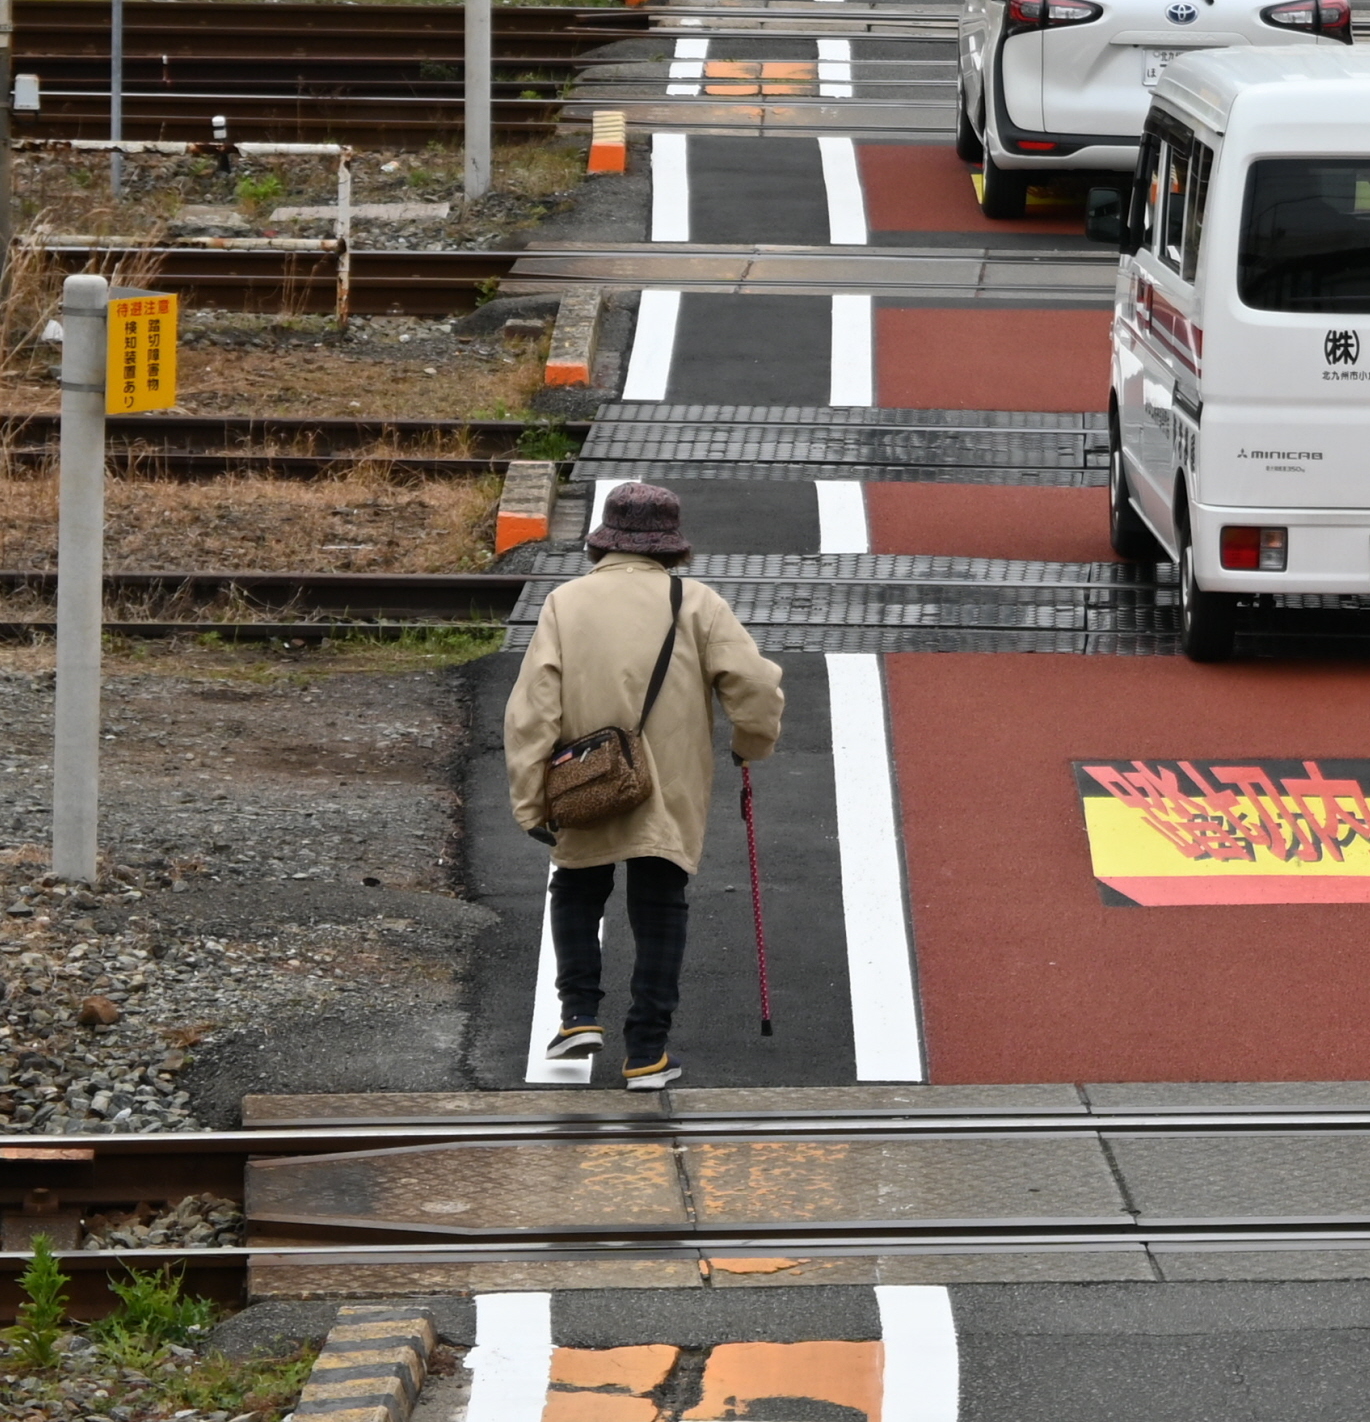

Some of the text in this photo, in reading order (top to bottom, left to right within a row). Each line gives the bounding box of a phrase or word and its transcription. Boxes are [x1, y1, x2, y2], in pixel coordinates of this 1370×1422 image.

[1147, 68, 1157, 78] ほ
[117, 299, 170, 318] 待避注意
[123, 321, 138, 409] 検知装置あり
[146, 319, 161, 392] 踏切障害物
[1251, 450, 1323, 460] MINICAB
